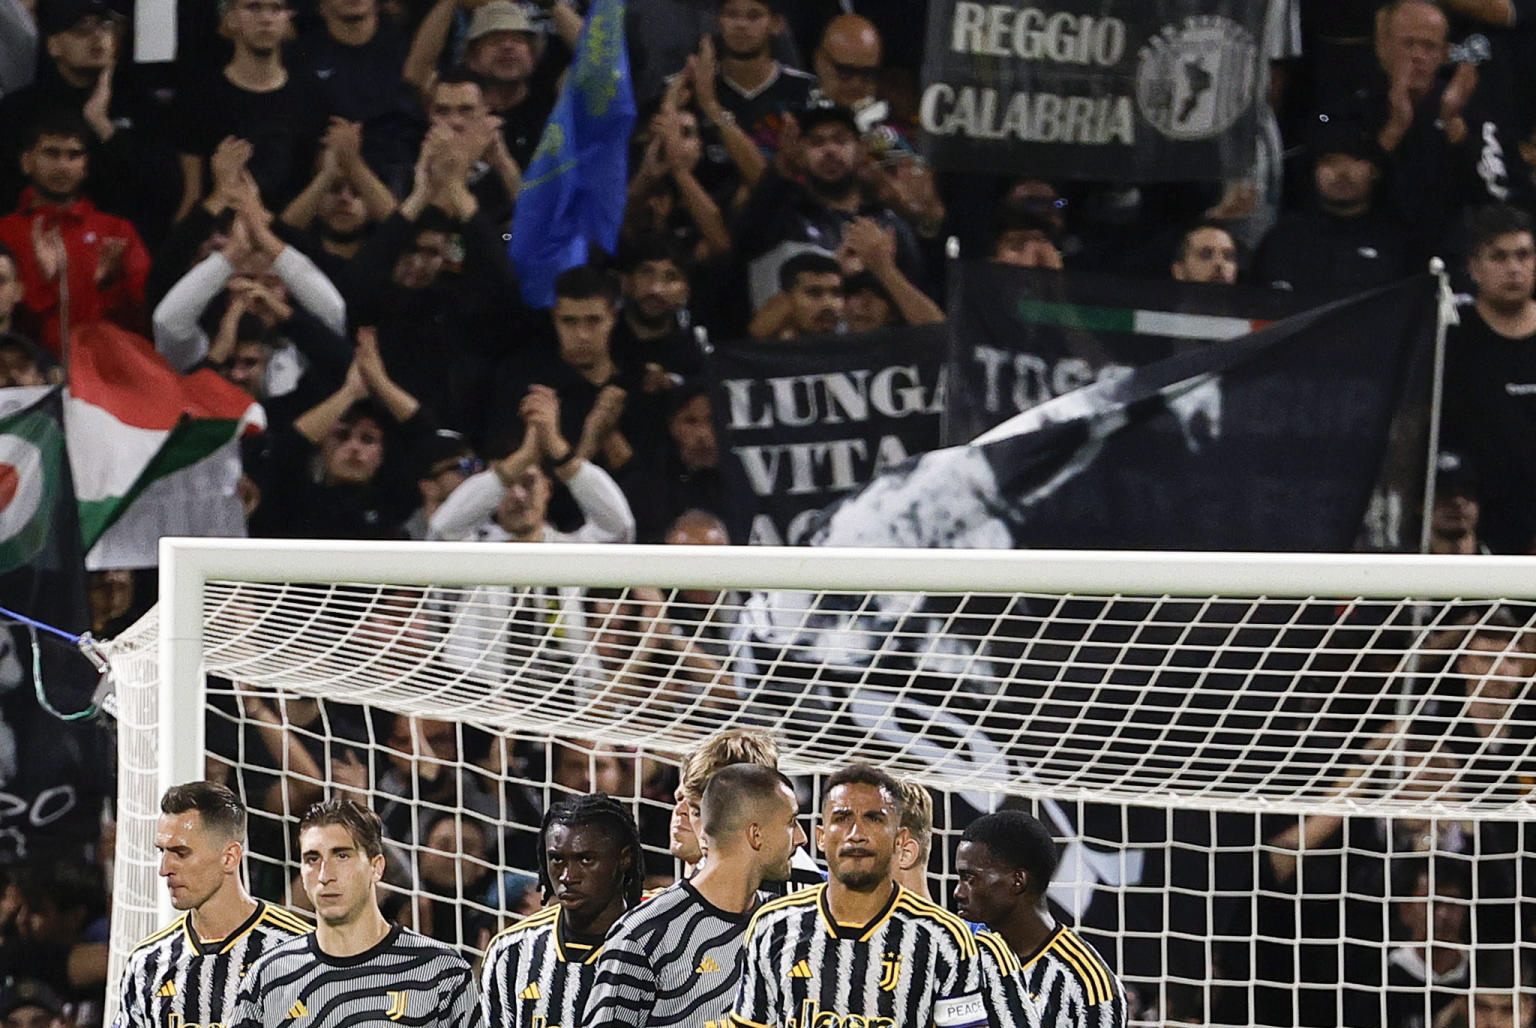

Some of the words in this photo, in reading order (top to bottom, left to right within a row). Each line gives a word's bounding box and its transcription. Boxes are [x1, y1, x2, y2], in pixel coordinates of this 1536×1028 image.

[951, 2, 1127, 67] REGGIO
[919, 82, 1136, 146] CALABRIA
[731, 434, 912, 497] VITA
